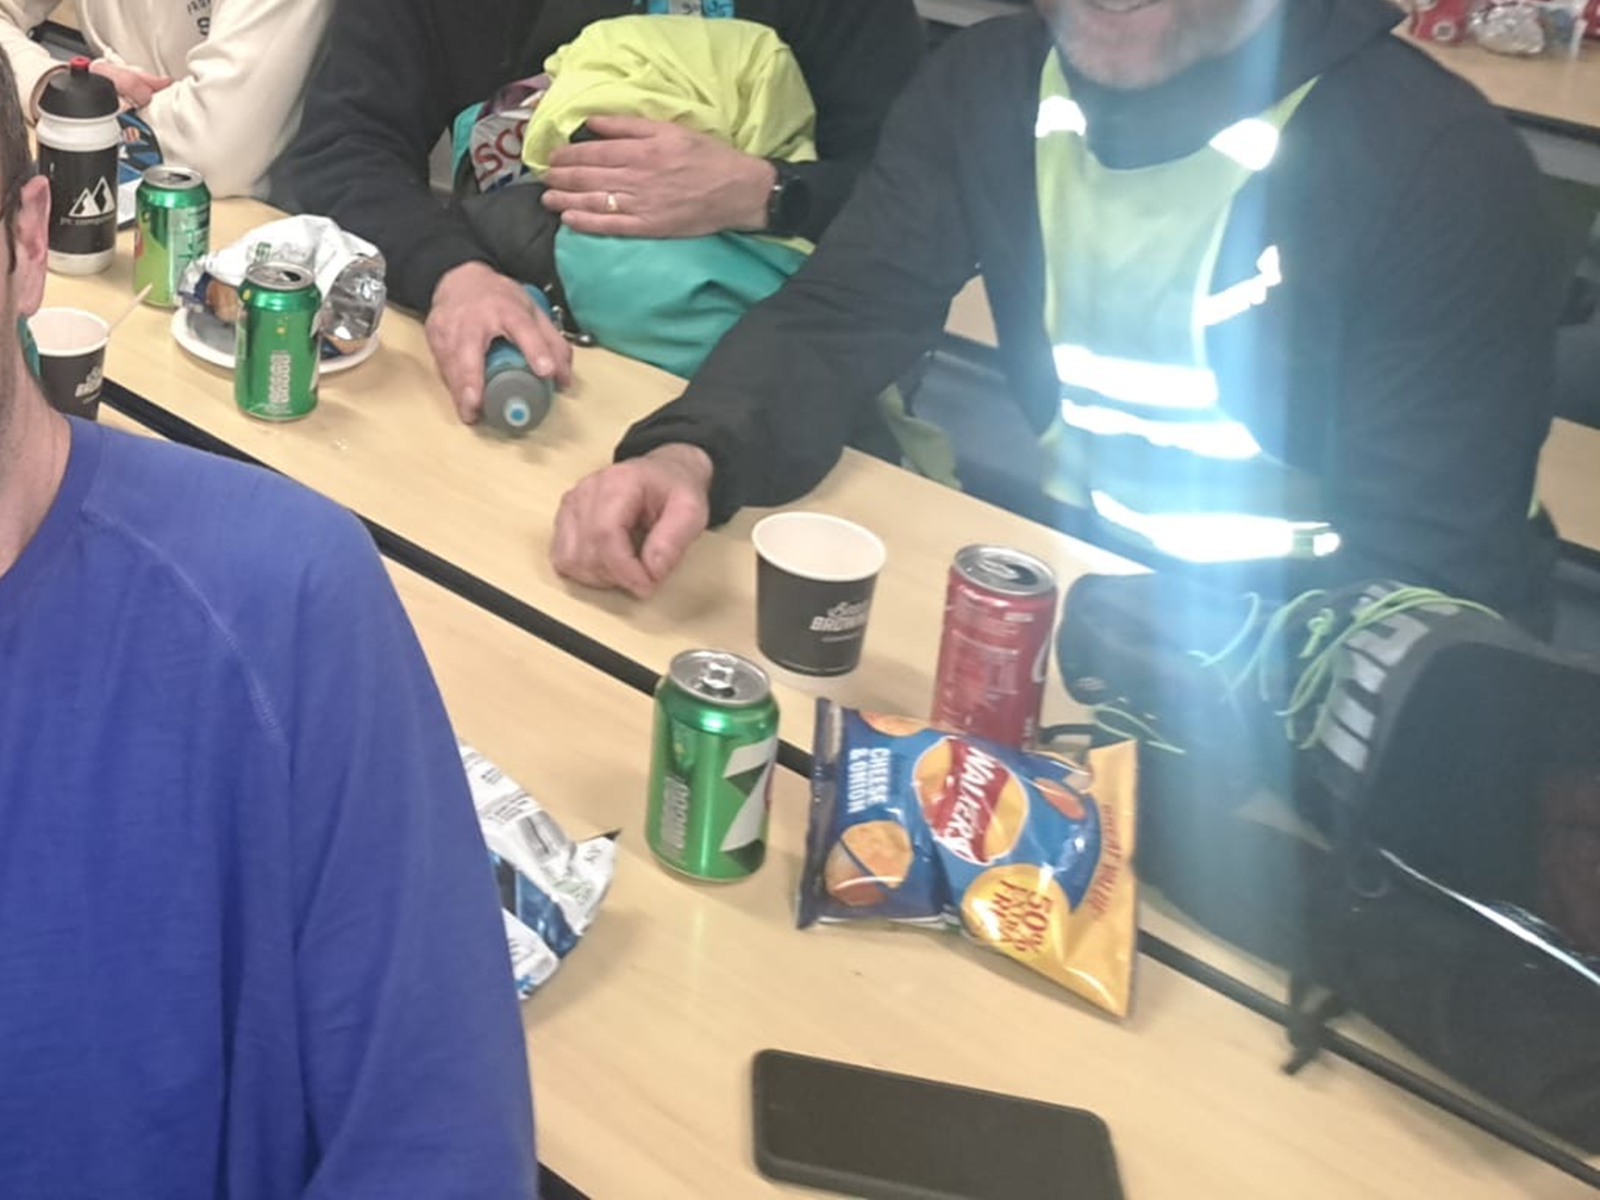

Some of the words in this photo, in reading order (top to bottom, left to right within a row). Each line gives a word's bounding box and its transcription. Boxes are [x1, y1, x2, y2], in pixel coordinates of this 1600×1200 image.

[847, 761, 868, 814] ONION
[867, 748, 892, 804] CHEESE
[943, 746, 996, 857] WALKERS
[1015, 891, 1053, 953] 50%
